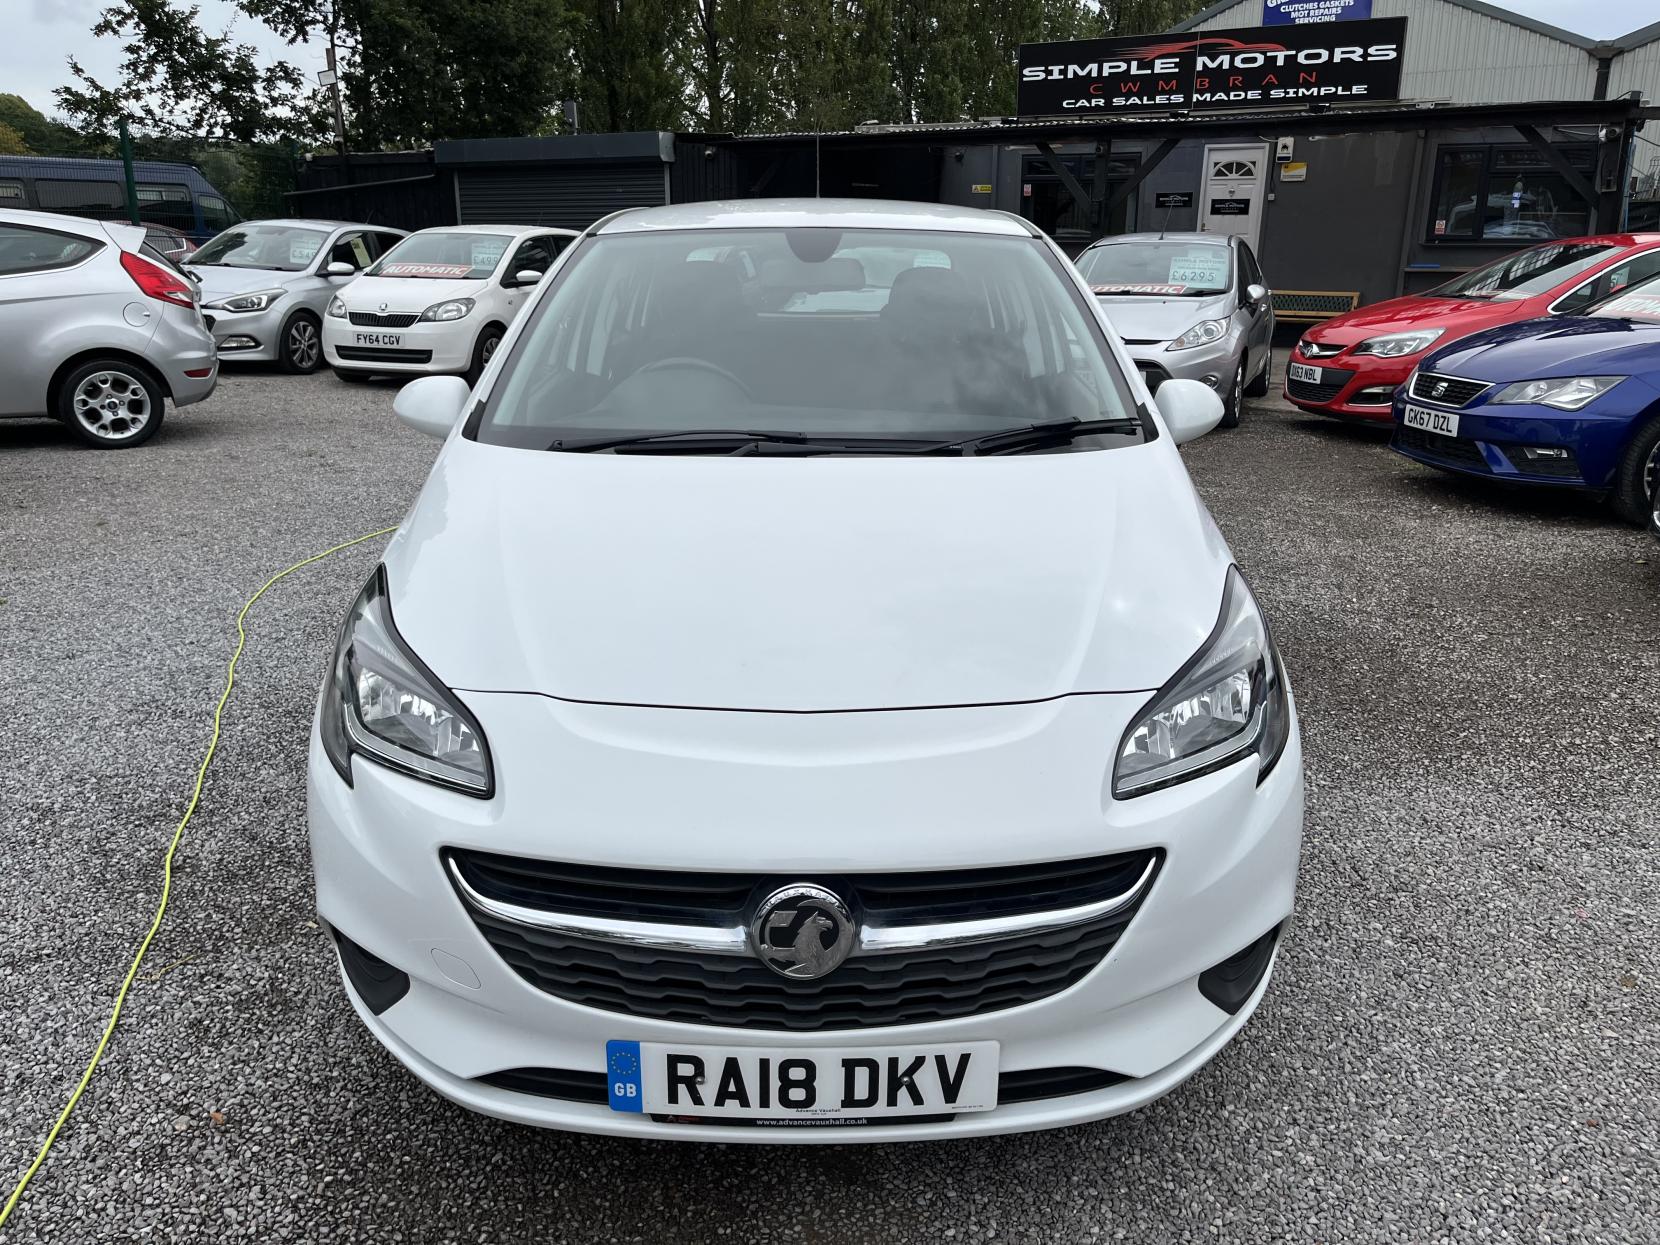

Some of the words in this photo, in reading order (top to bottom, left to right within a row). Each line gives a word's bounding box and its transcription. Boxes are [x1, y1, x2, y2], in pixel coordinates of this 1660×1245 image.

[1280, 2, 1318, 12] CLUTCHES
[1319, 0, 1355, 8] GASKETS
[1290, 10, 1309, 19] MOT
[1309, 7, 1342, 16] REPAIRS
[1295, 15, 1336, 24] SERVICING
[1022, 58, 1180, 82] SIMPLE
[1196, 44, 1398, 71] MOTORS
[1089, 71, 1318, 95] CWMBRAN
[1062, 97, 1106, 108] CAR
[1112, 94, 1184, 106] SALES
[1193, 90, 1263, 102] MADE
[1269, 85, 1368, 99] SIMPLE
[383, 265, 468, 275] AUTOMATIC
[1171, 270, 1215, 282] £6295
[1092, 285, 1182, 294] UTOMATIC
[356, 333, 380, 345] FY64
[382, 334, 401, 346] CGV
[1304, 367, 1317, 381] NBL
[1407, 408, 1432, 428] GK67
[1432, 413, 1453, 433] DZL
[666, 1053, 817, 1109] RA18
[841, 1053, 972, 1109] DKV
[614, 1082, 637, 1098] GB
[756, 1117, 868, 1126] www.advancevauxhall.co.uk
